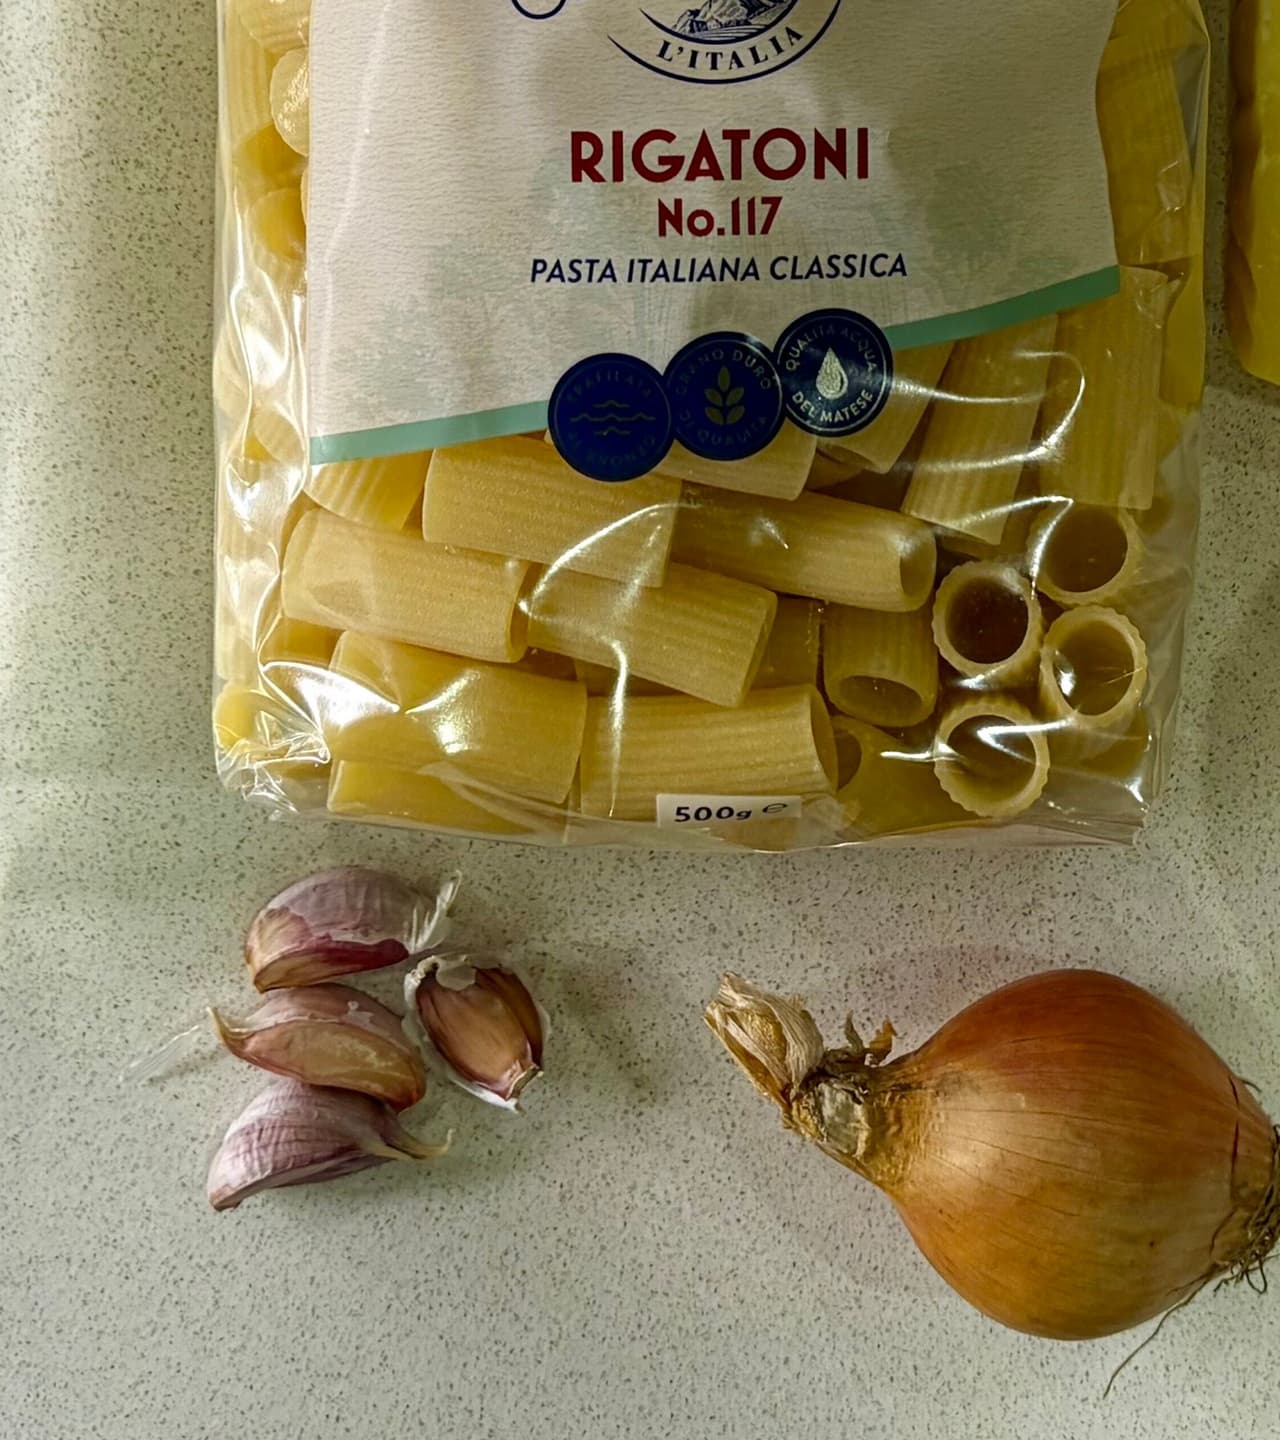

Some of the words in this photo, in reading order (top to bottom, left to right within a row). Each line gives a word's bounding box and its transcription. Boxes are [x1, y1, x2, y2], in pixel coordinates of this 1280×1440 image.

[655, 26, 805, 72] L'ITALIA
[570, 126, 870, 184] RIGATONI
[657, 195, 783, 238] No.117
[530, 258, 619, 284] PASTA
[626, 256, 761, 284] ITALIANA
[768, 252, 909, 283] CLASSICA
[731, 349, 772, 391] DURO
[791, 390, 818, 420] DEL
[818, 388, 874, 424] MATESE
[674, 805, 753, 823] 500g
